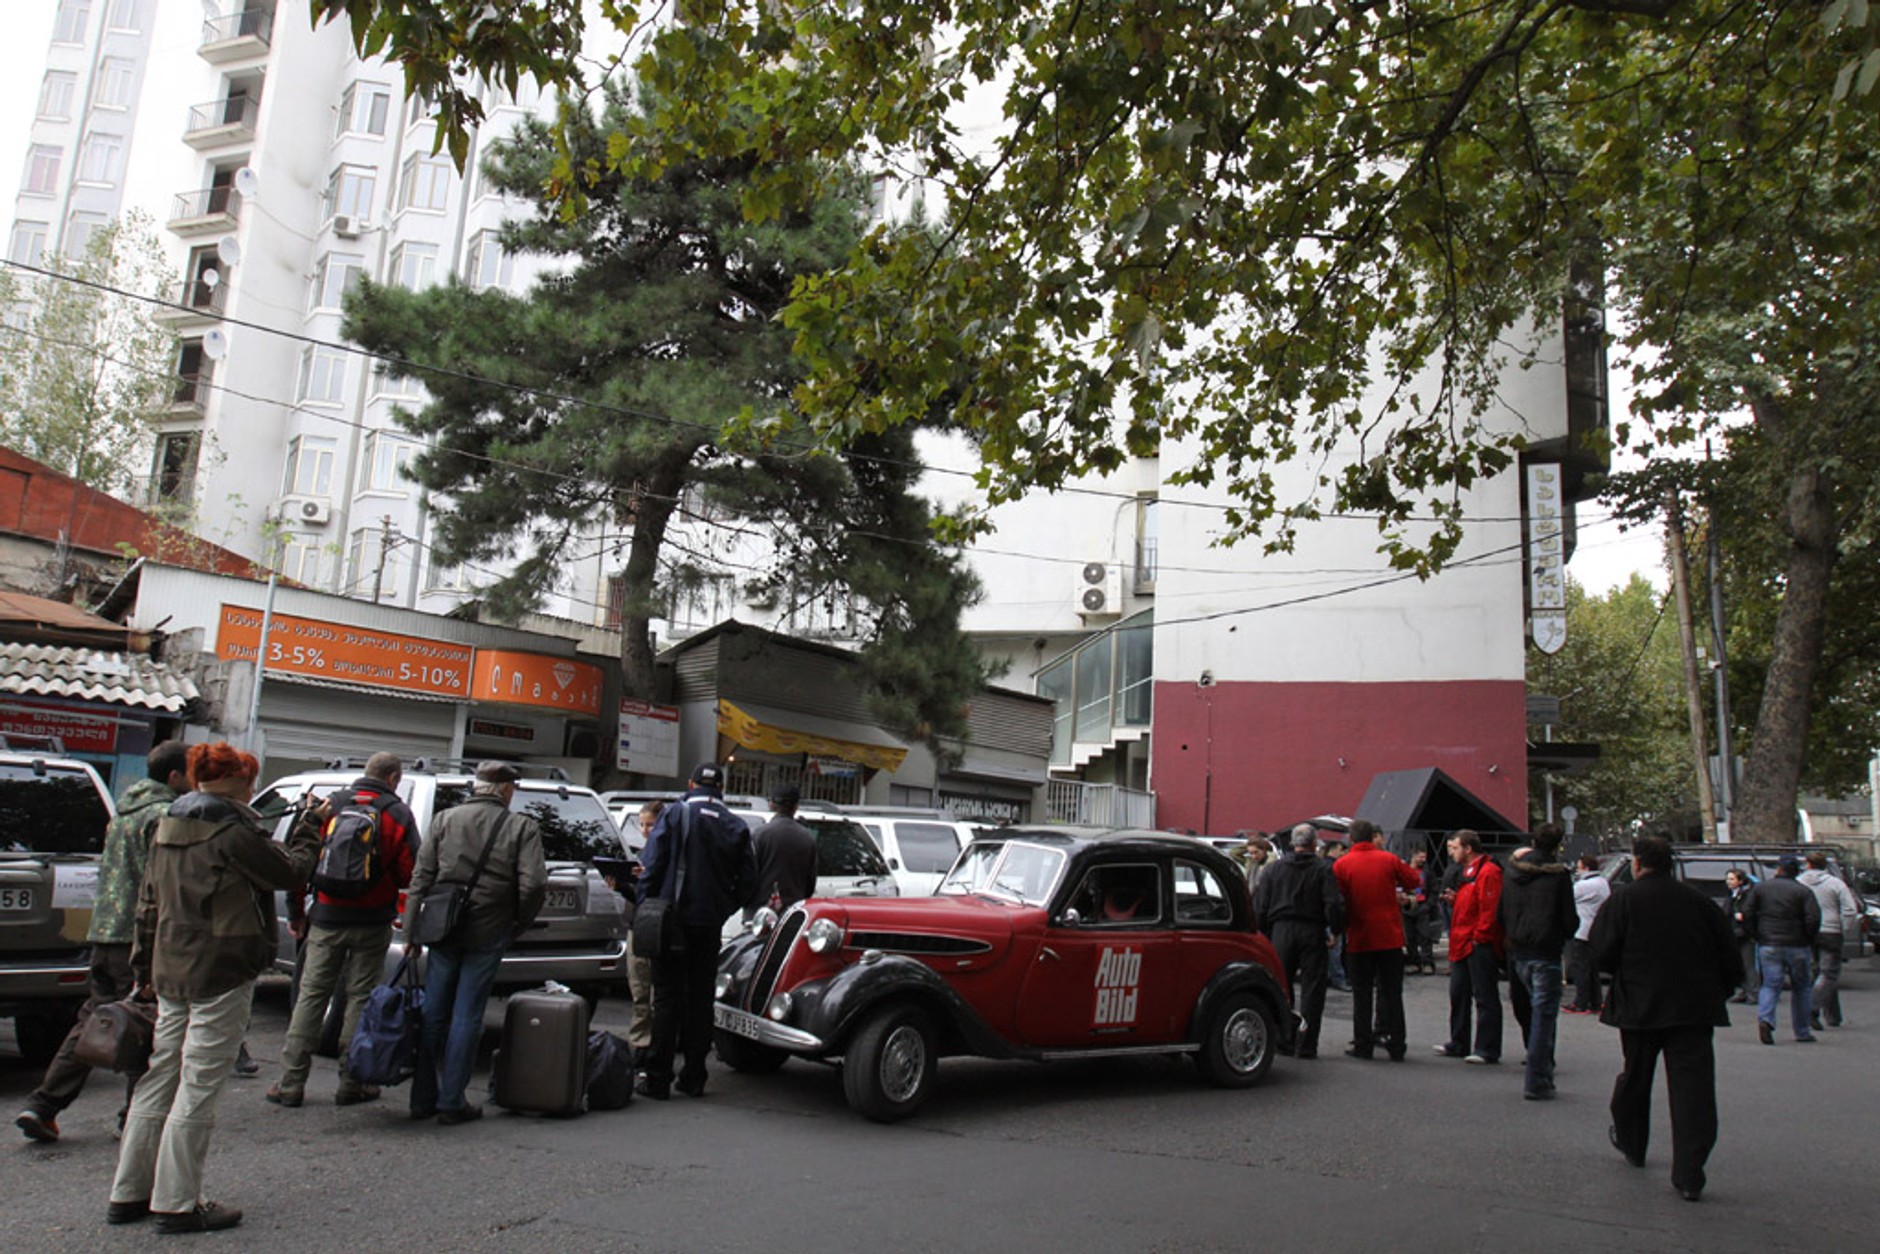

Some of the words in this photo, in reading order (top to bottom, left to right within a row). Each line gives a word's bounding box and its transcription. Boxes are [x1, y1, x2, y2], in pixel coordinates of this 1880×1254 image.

[269, 641, 325, 668] 3-5%
[398, 662, 461, 689] 5-10%
[1094, 946, 1142, 988] Auto
[1094, 988, 1138, 1024] Bild
